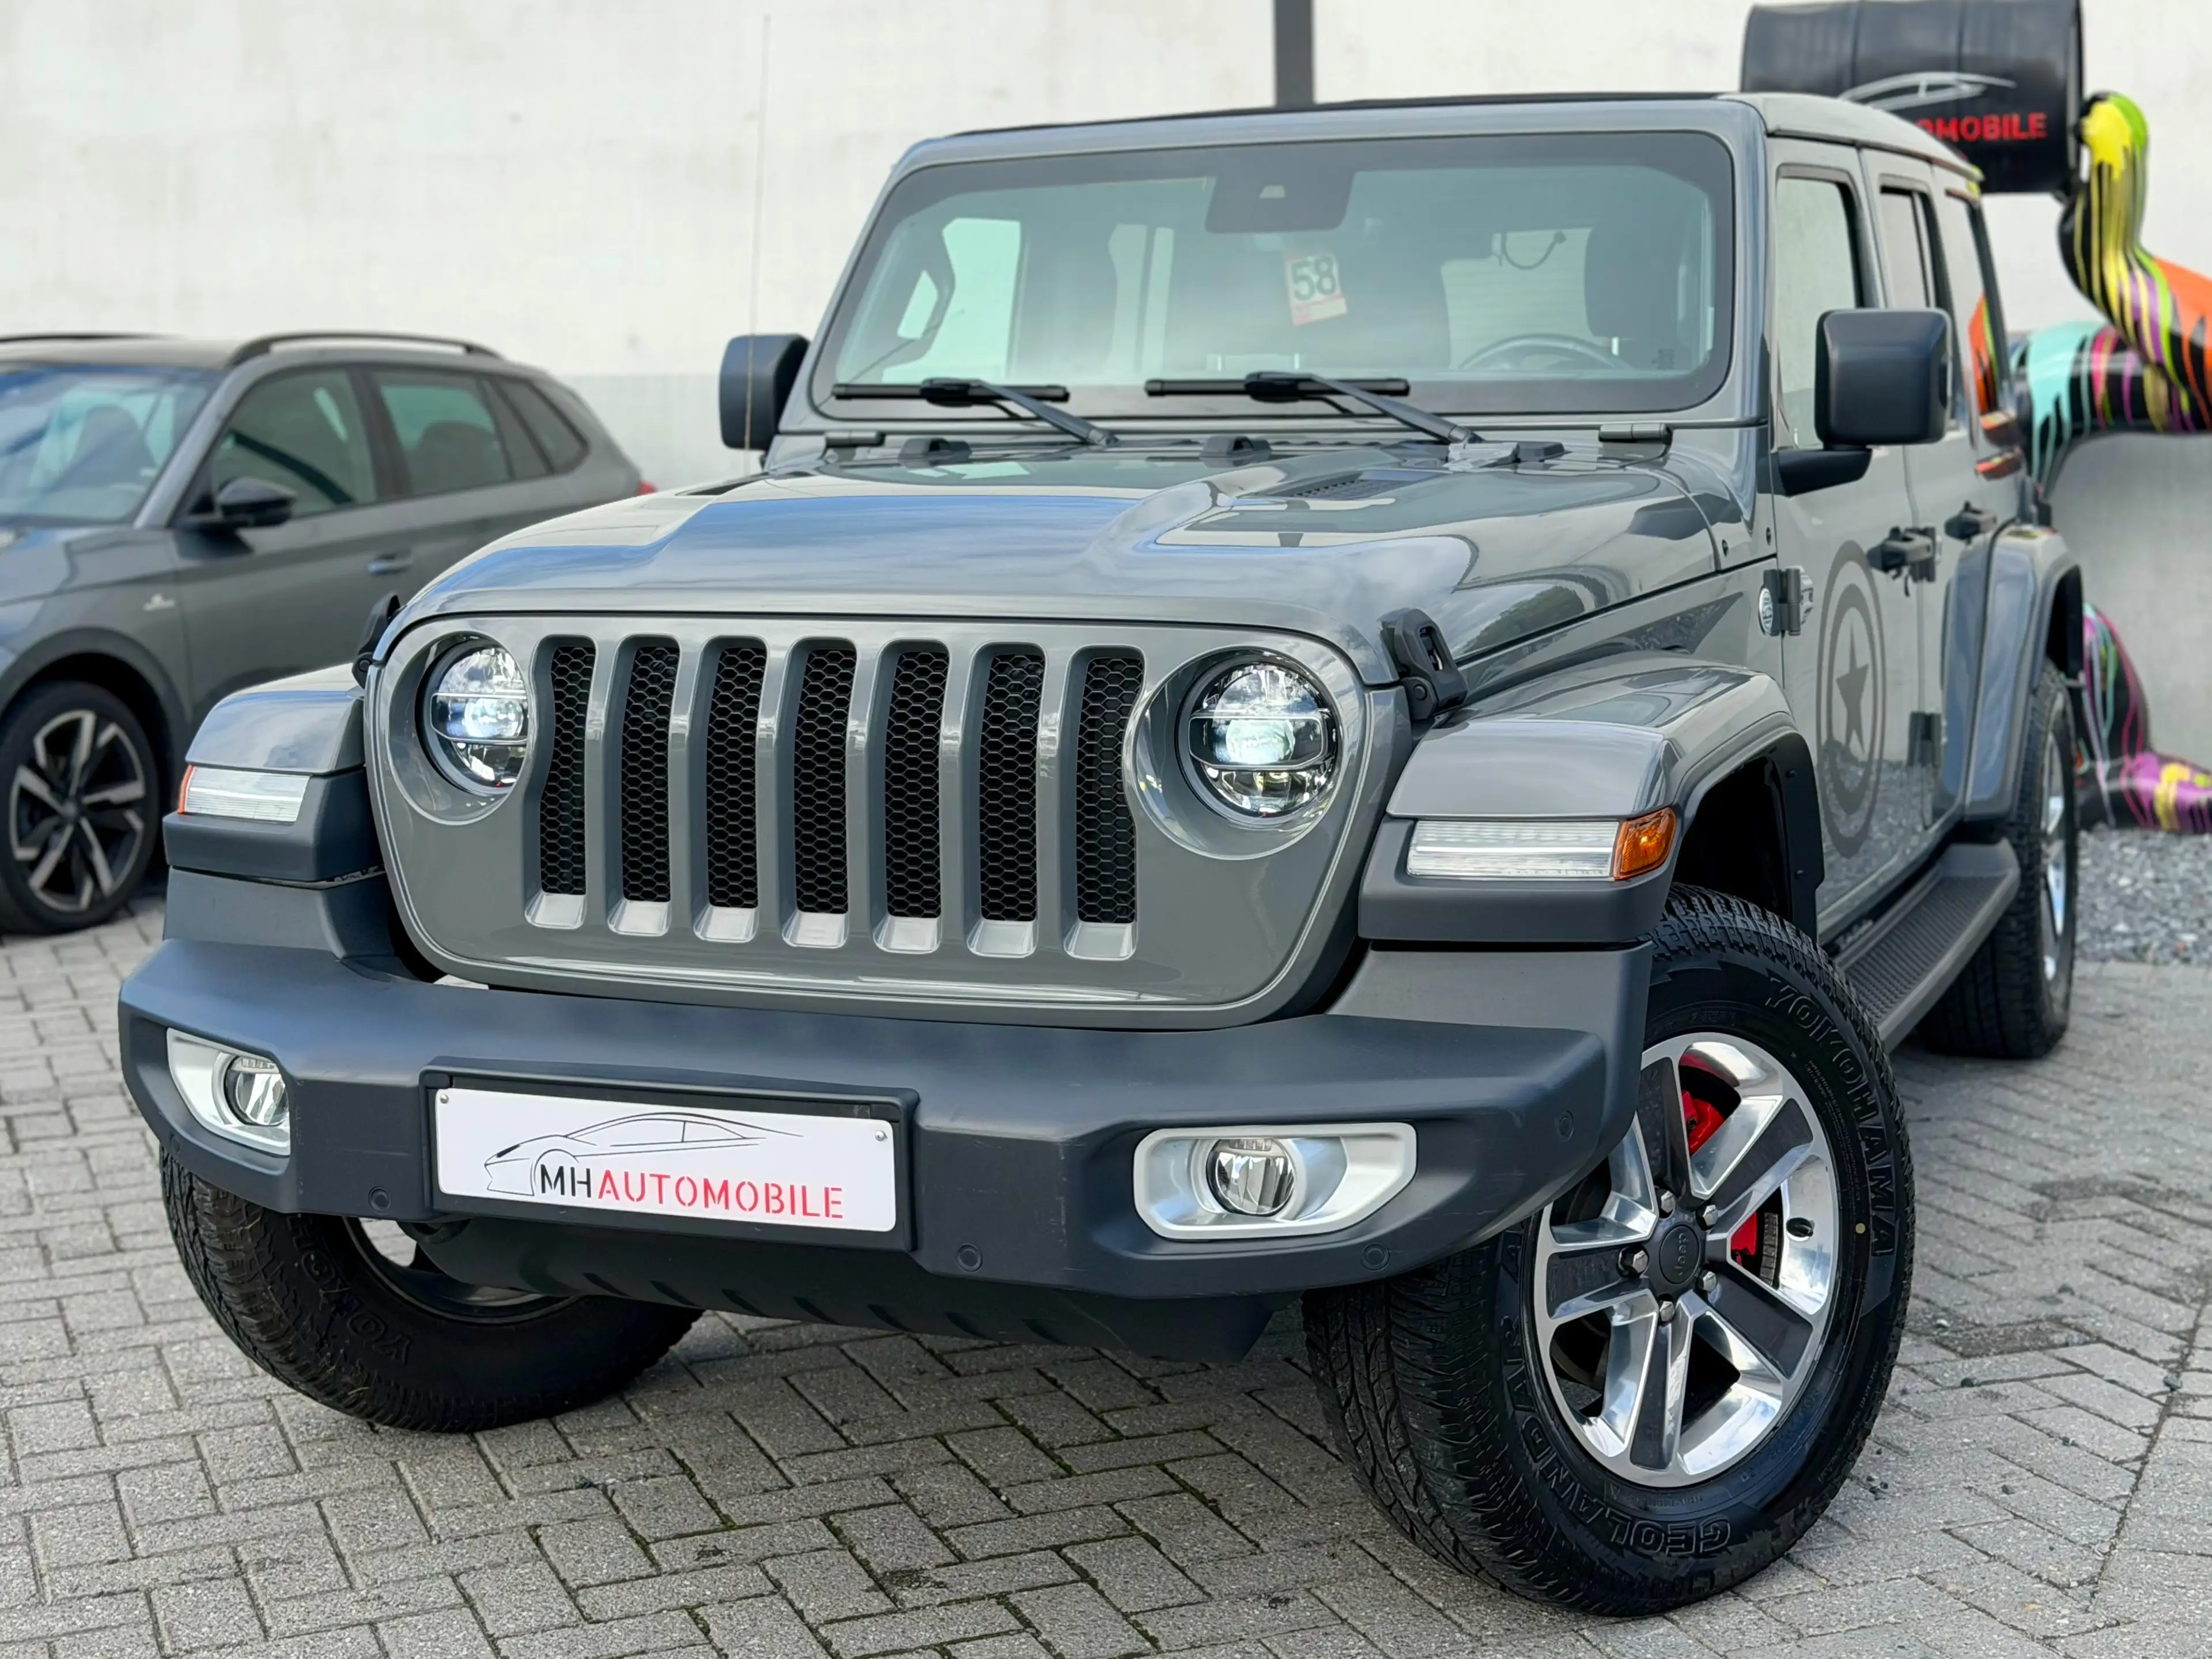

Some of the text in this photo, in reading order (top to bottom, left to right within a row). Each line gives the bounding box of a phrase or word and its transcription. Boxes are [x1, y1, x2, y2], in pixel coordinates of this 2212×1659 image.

[1292, 257, 1336, 301] 58
[1764, 977, 1896, 1257] YOKOHAMA
[1673, 1232, 1690, 1277] Jeep
